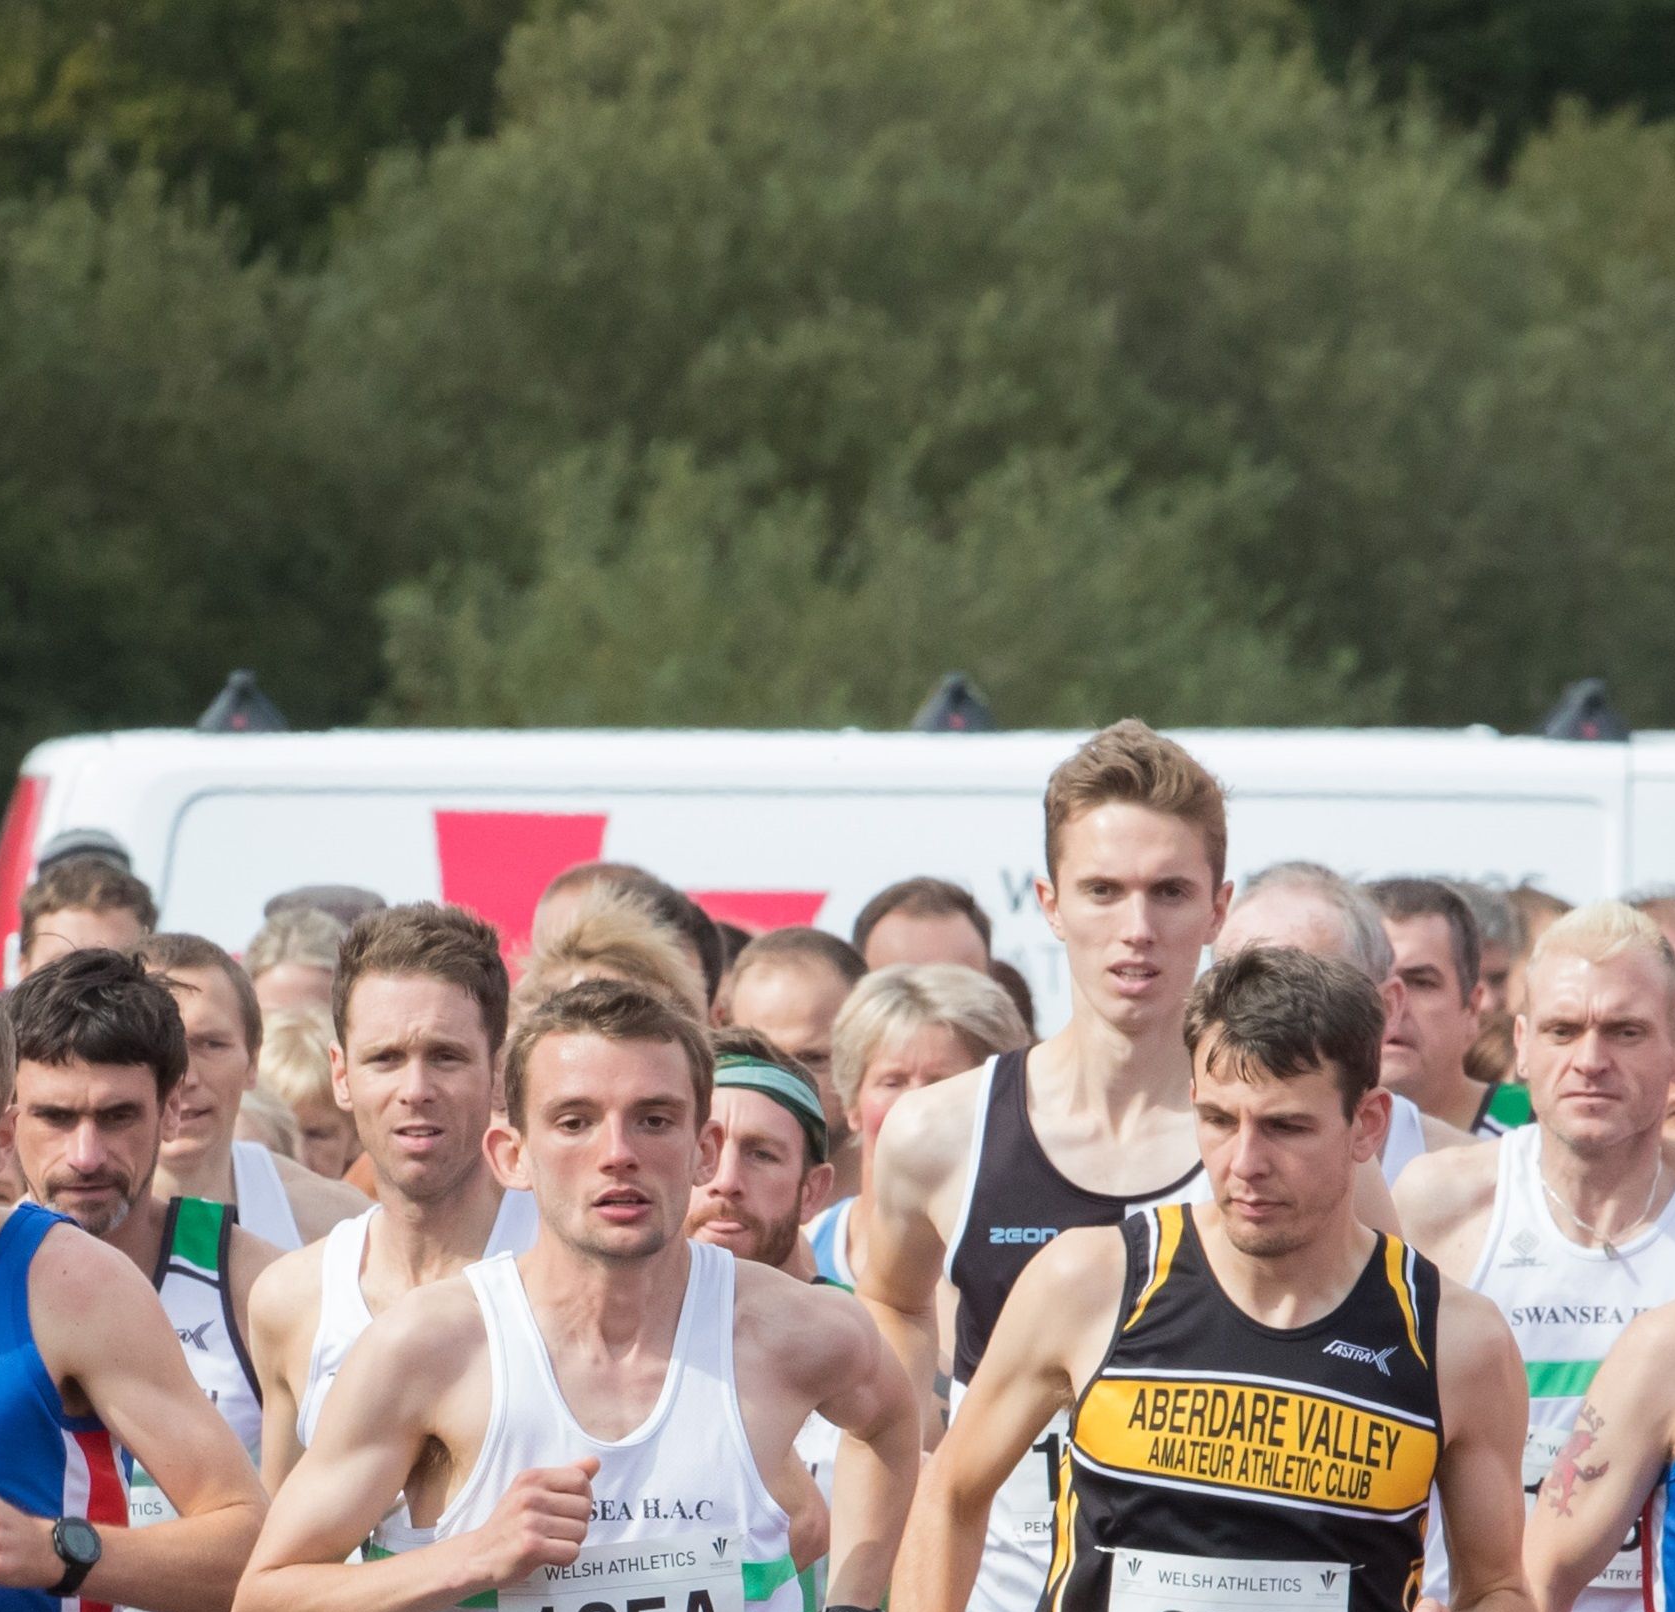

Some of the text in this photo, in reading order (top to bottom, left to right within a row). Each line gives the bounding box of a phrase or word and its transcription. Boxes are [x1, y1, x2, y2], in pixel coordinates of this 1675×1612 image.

[1511, 1306, 1624, 1326] SWANSEA
[1128, 1388, 1401, 1471] ABERDARE VALLEY
[1148, 1437, 1372, 1500] AMATEUR ATHLETIC CLUB
[545, 1563, 603, 1581] WELSH
[608, 1551, 696, 1576] ATHLETICS
[1158, 1569, 1213, 1589] WELSH
[1217, 1575, 1302, 1593] ATHLETICS
